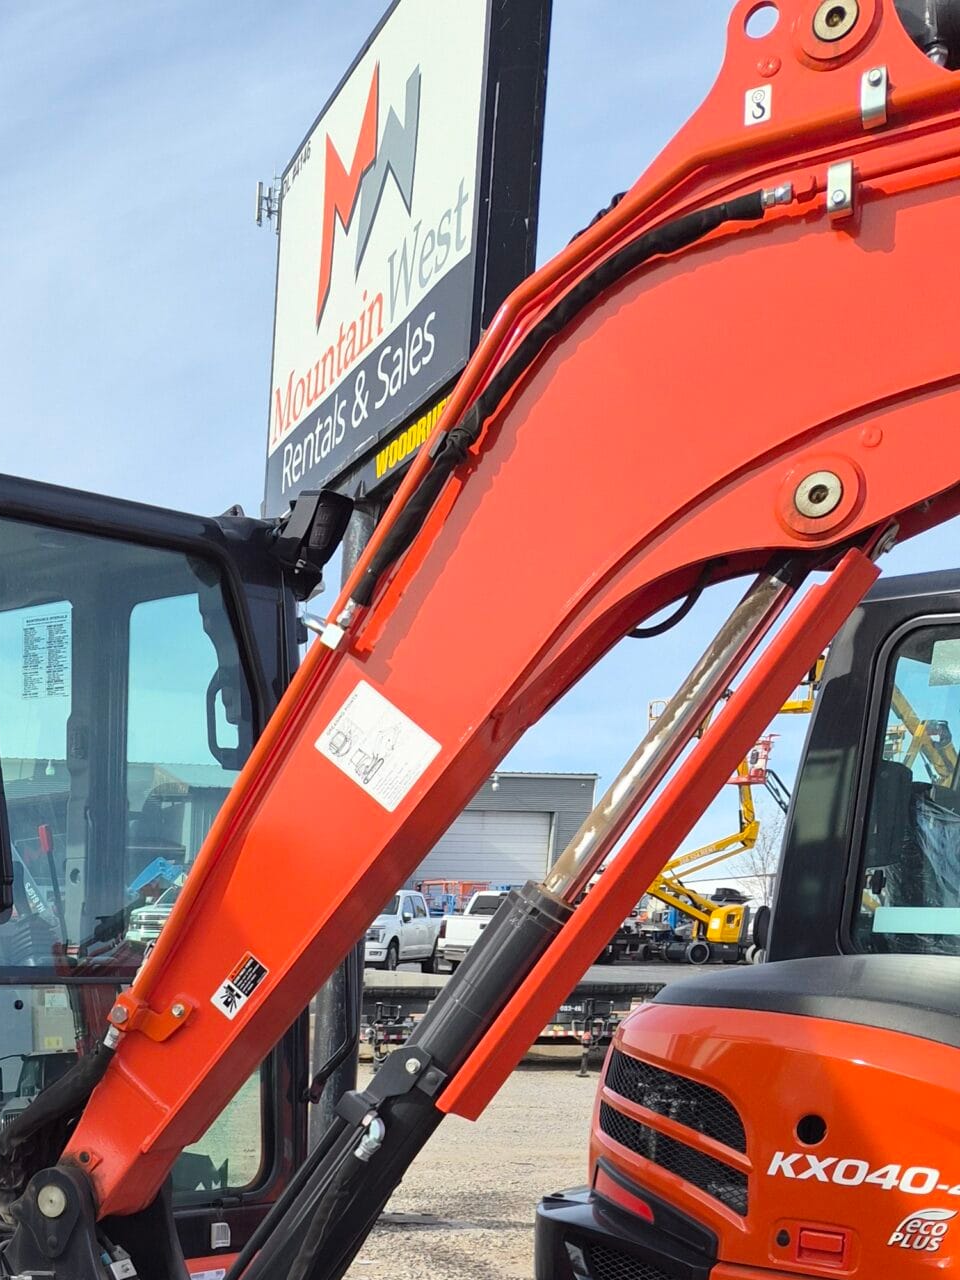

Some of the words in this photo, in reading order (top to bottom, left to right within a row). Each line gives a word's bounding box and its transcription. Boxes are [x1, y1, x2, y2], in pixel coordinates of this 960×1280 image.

[272, 290, 384, 444] Mountain
[388, 176, 469, 323] West
[282, 394, 347, 494] Rentals
[352, 370, 369, 428] &
[375, 312, 436, 409] Sales
[887, 1232, 944, 1252] PLUS
[905, 1219, 949, 1237] eco
